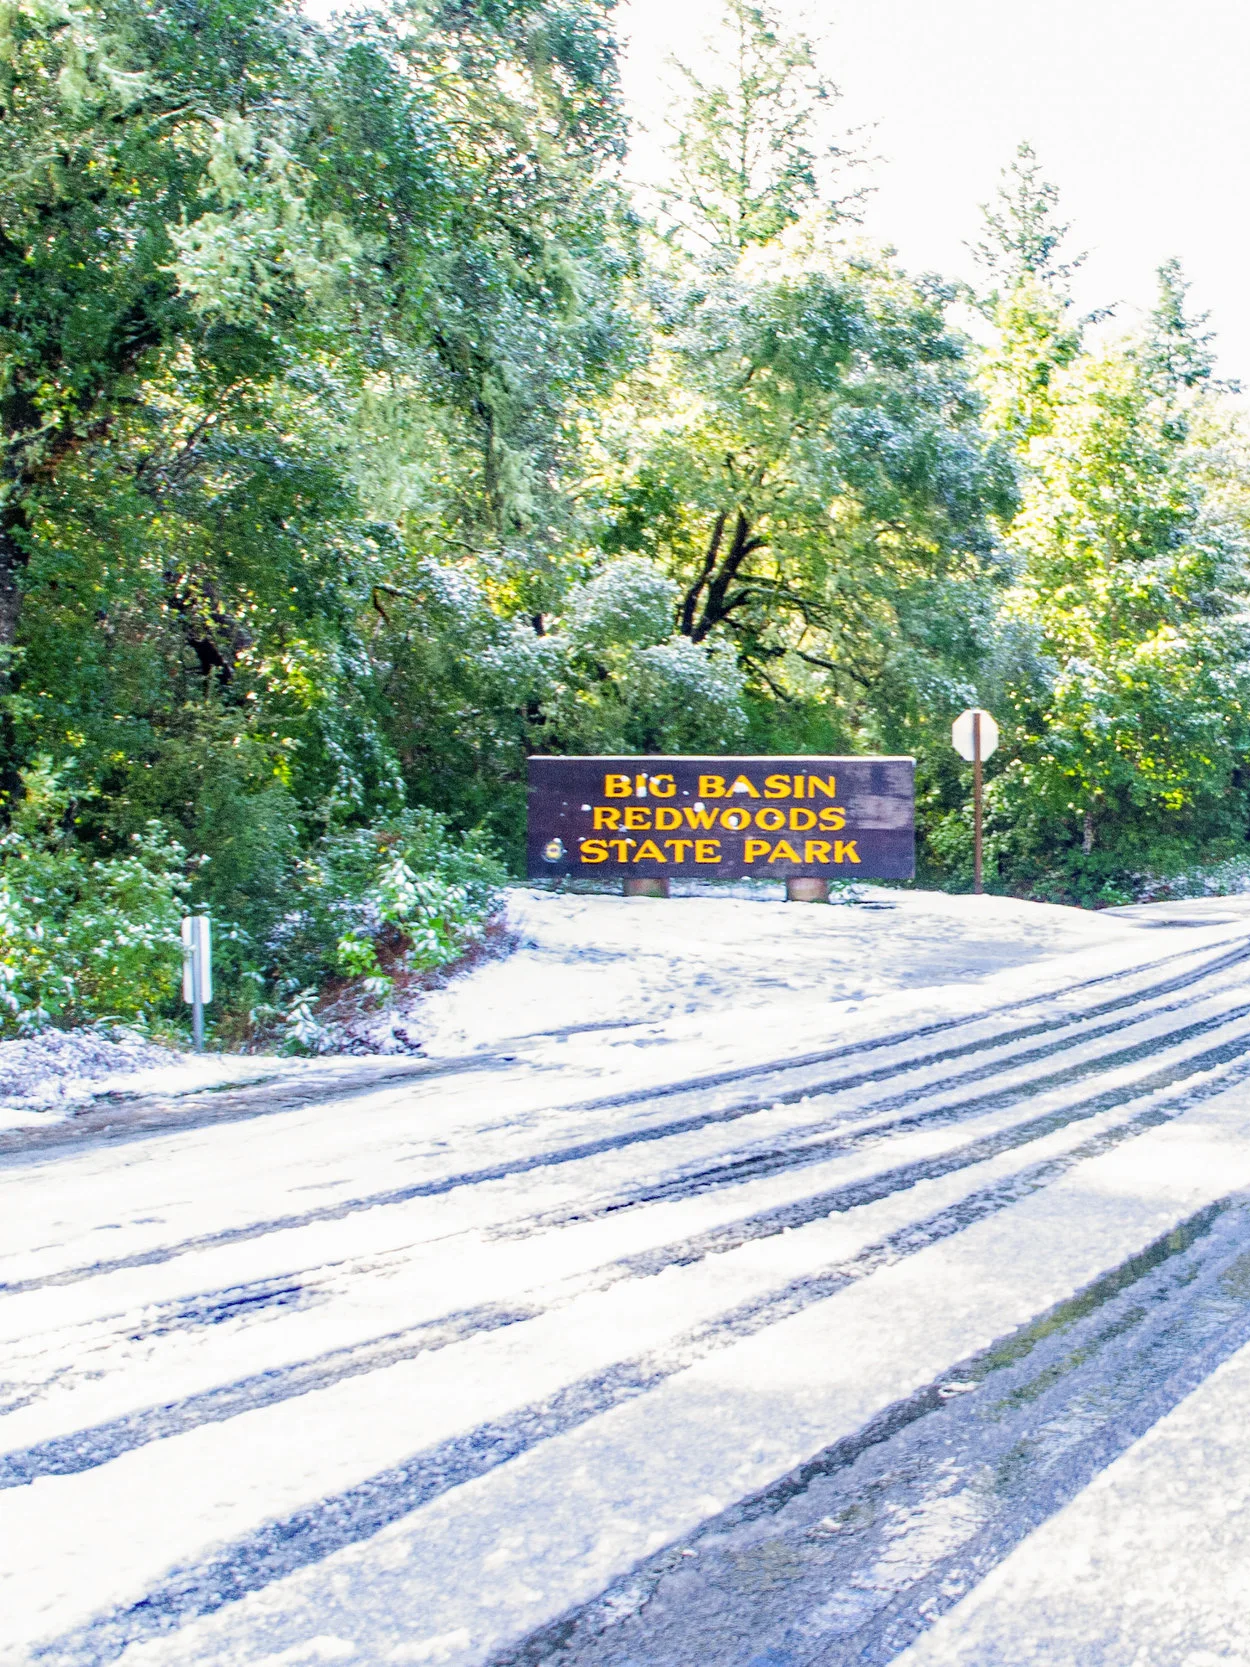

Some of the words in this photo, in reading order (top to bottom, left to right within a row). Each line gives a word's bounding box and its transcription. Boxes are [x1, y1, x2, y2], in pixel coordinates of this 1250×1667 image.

[604, 774, 676, 798] BIG
[698, 773, 836, 799] BASIN
[592, 806, 846, 831] REDWOODS
[580, 838, 722, 864] STATE
[744, 839, 862, 864] PARK
